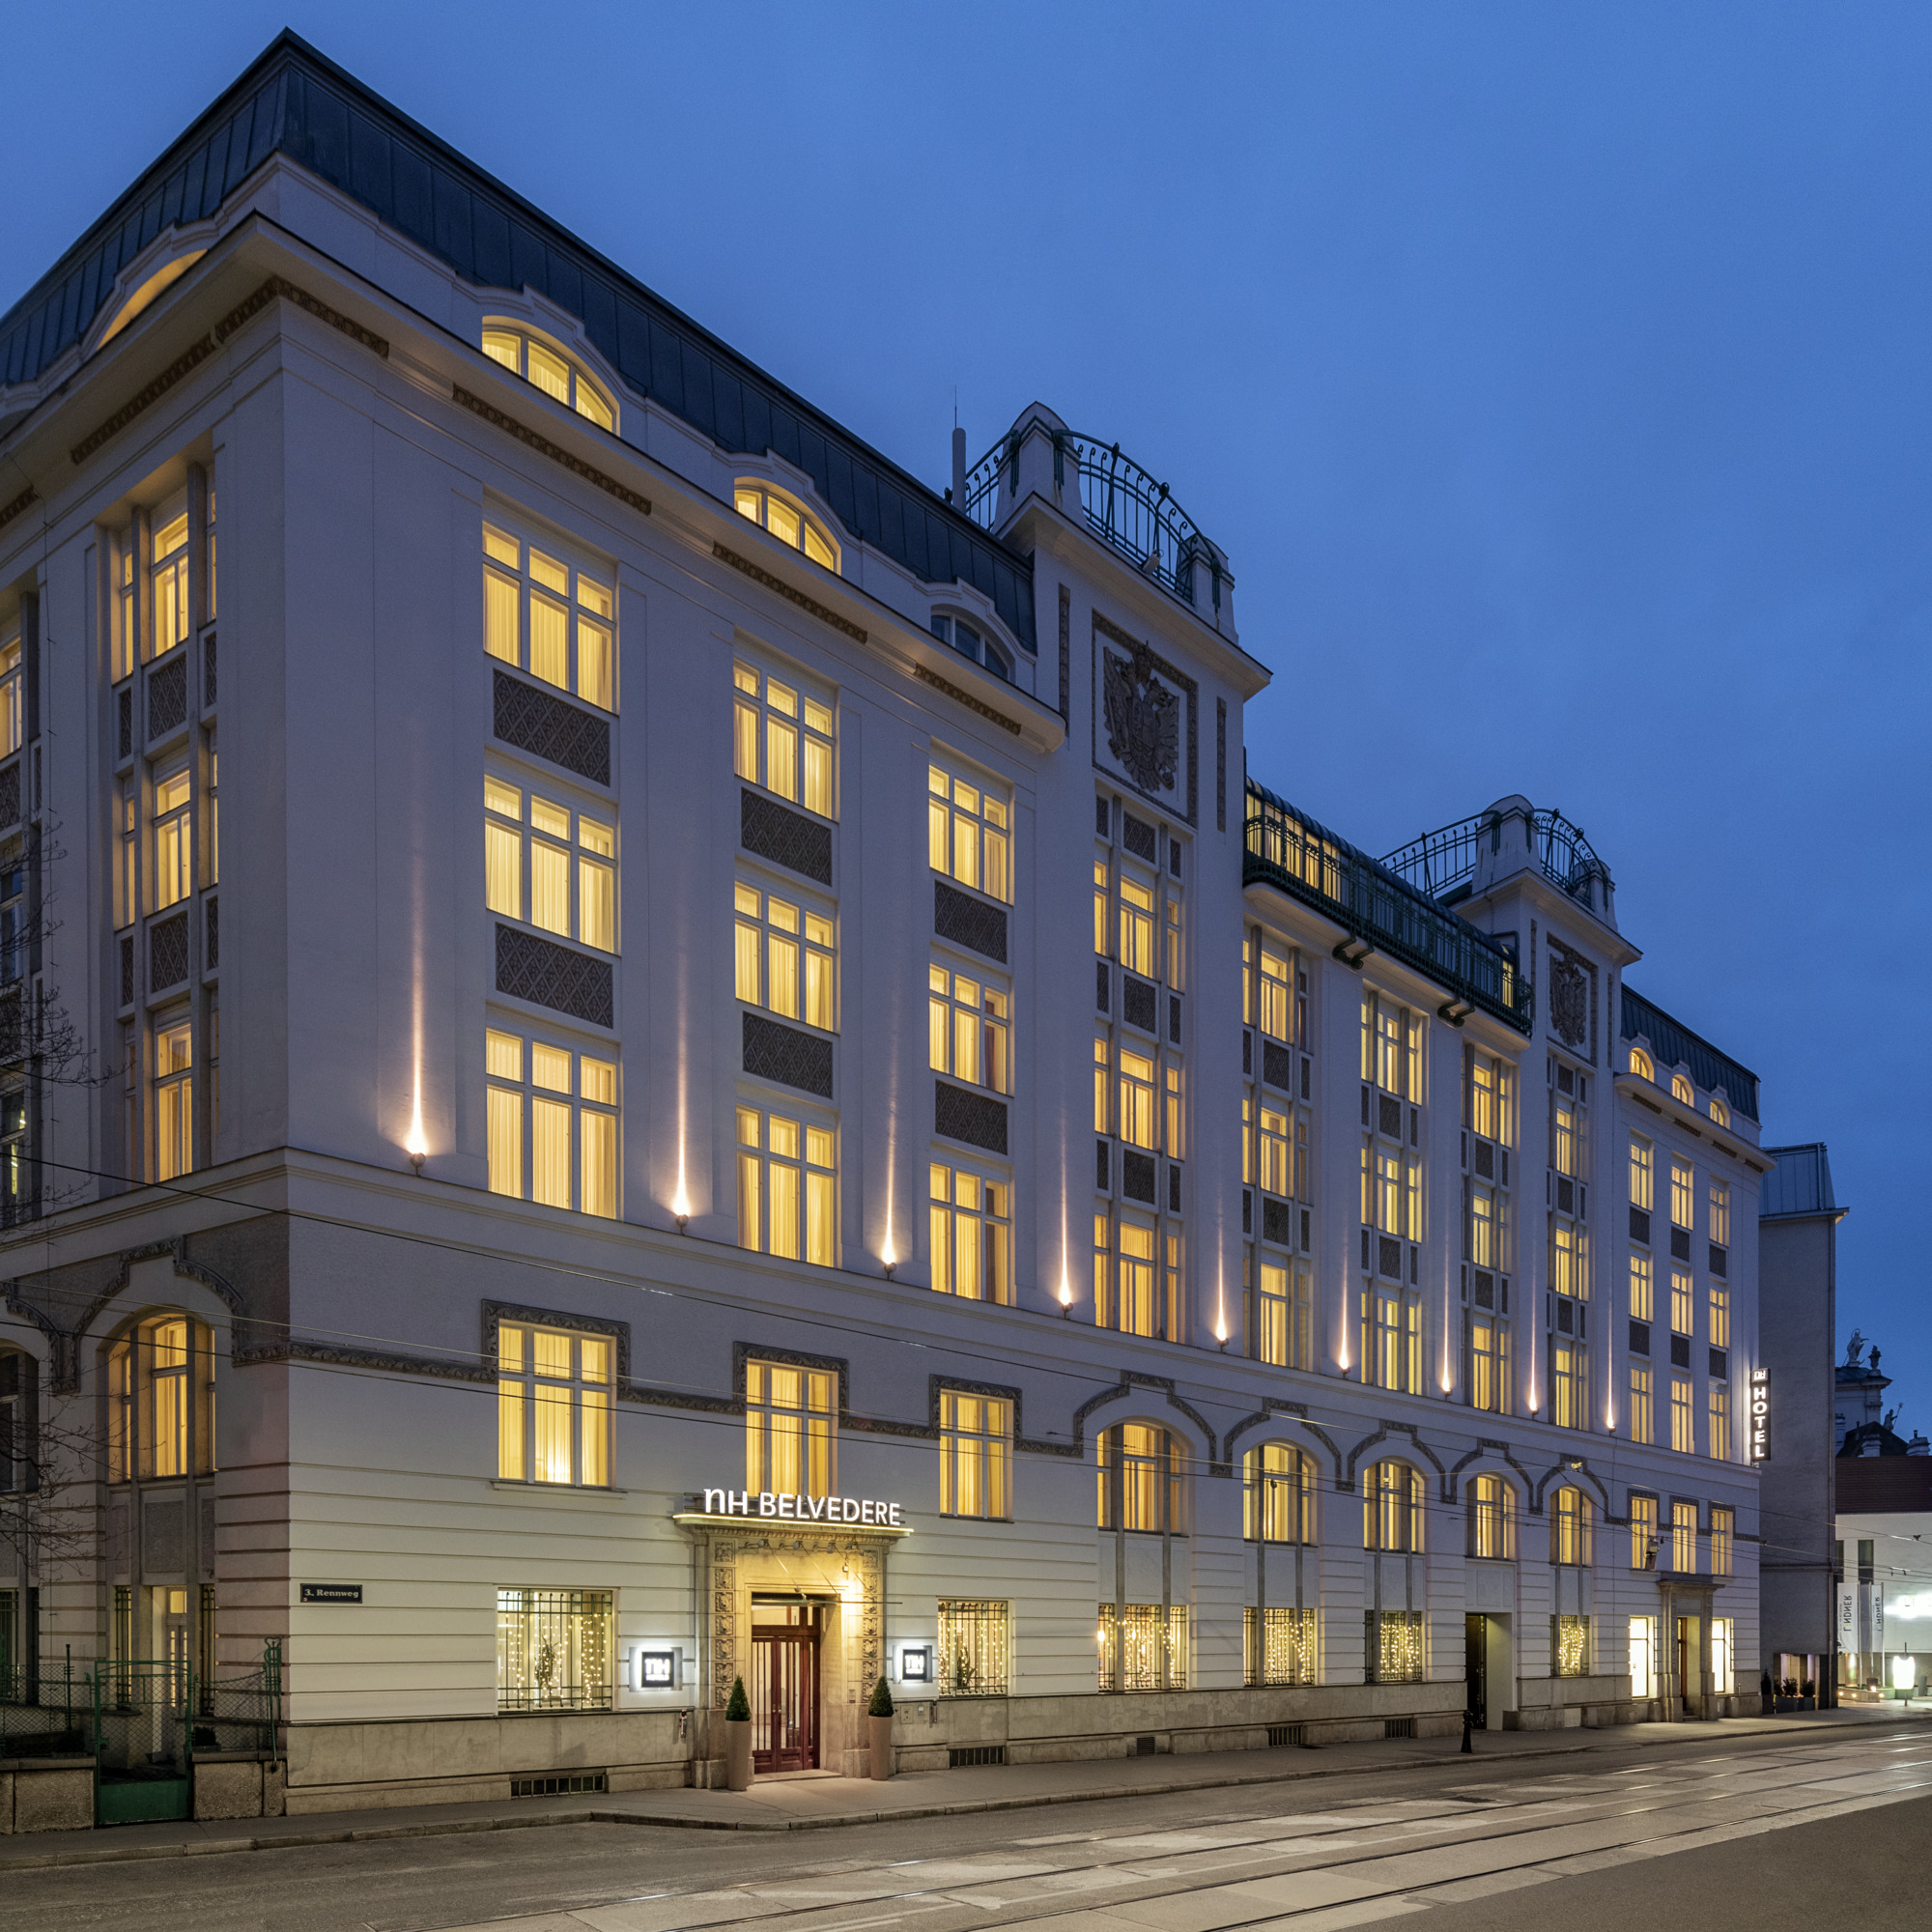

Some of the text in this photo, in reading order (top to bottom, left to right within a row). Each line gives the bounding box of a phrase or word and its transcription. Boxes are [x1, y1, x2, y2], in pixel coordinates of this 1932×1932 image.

[1752, 1386, 1768, 1457] HOTEL
[759, 1492, 901, 1526] BELVEDERE
[316, 1589, 359, 1598] Rennweg
